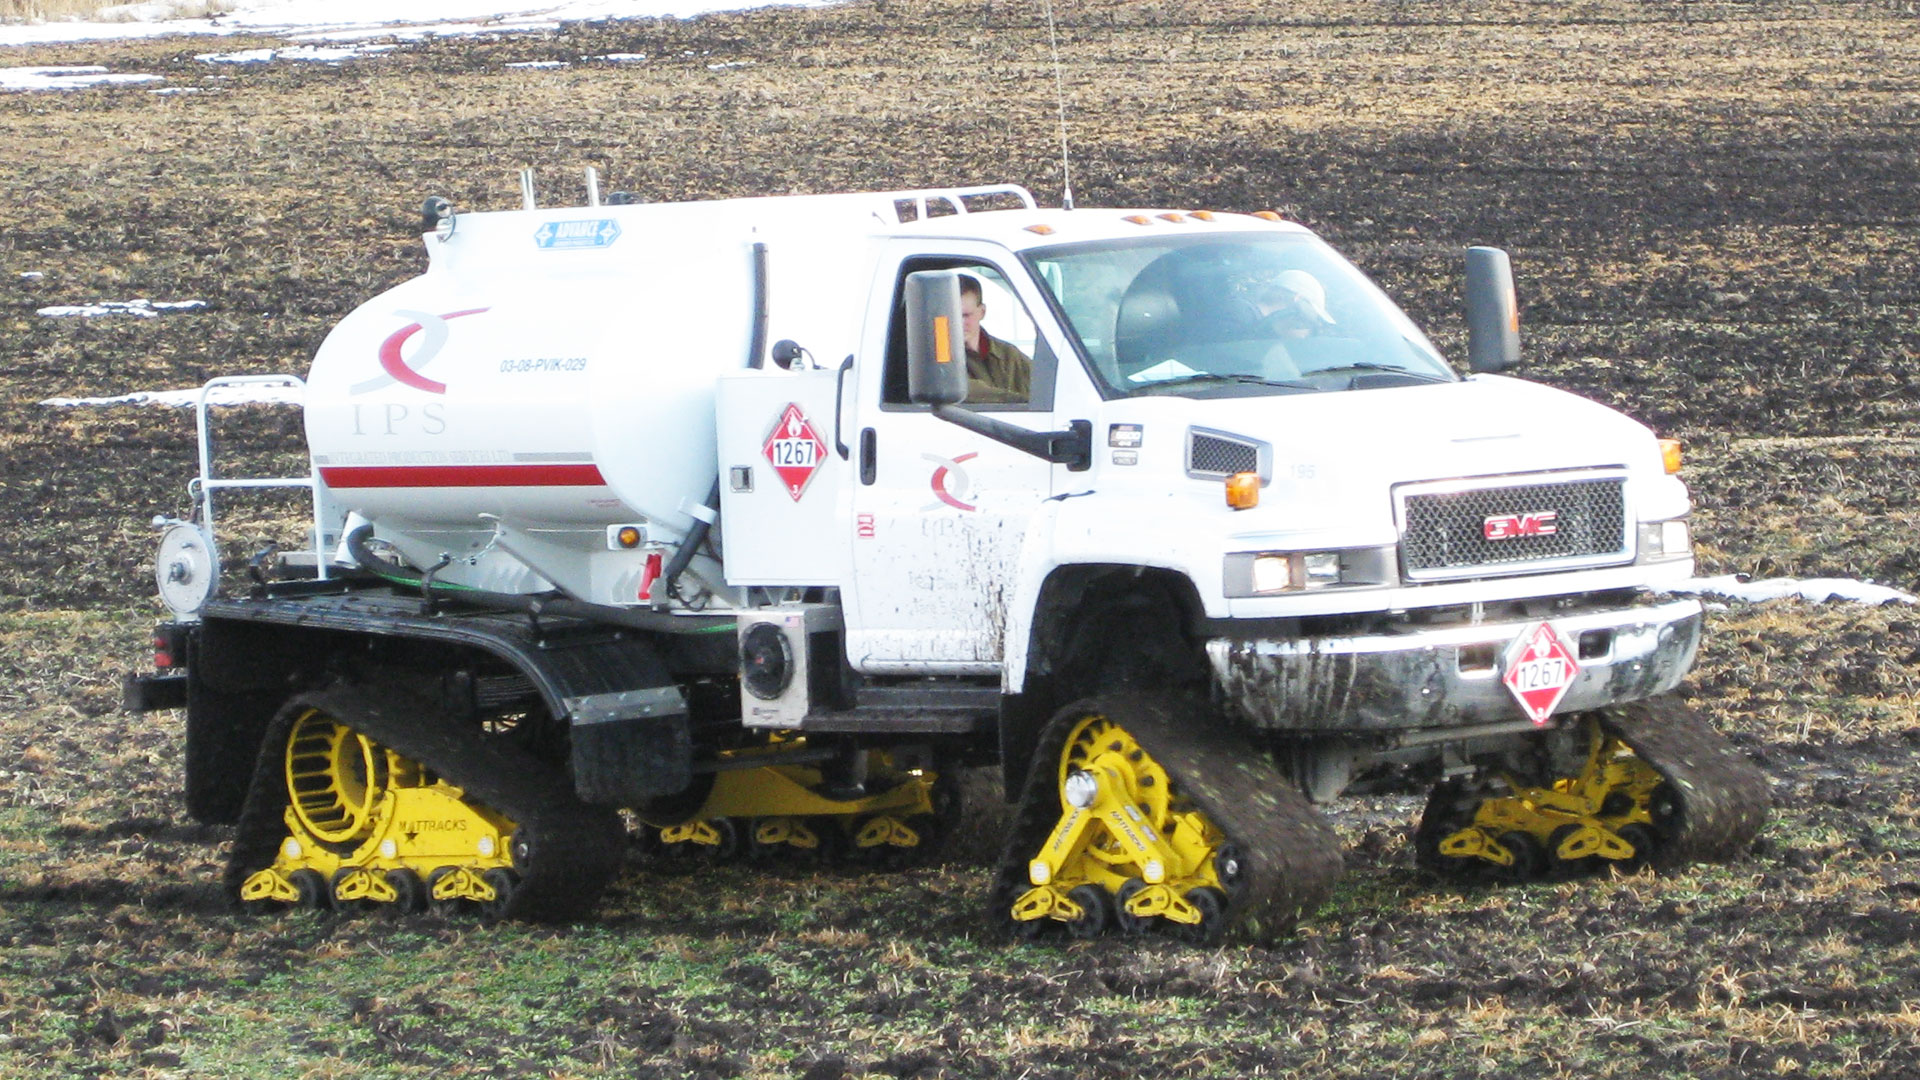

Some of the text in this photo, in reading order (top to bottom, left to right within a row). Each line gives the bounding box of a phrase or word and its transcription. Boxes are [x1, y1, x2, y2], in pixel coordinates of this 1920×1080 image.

[556, 220, 600, 239] ADVANCE
[500, 358, 587, 373] 03-08-PVIK-029
[352, 403, 447, 436] IPS
[774, 441, 815, 466] 1267
[792, 485, 799, 495] 3
[1483, 511, 1558, 541] GMC
[1520, 660, 1563, 689] 1267
